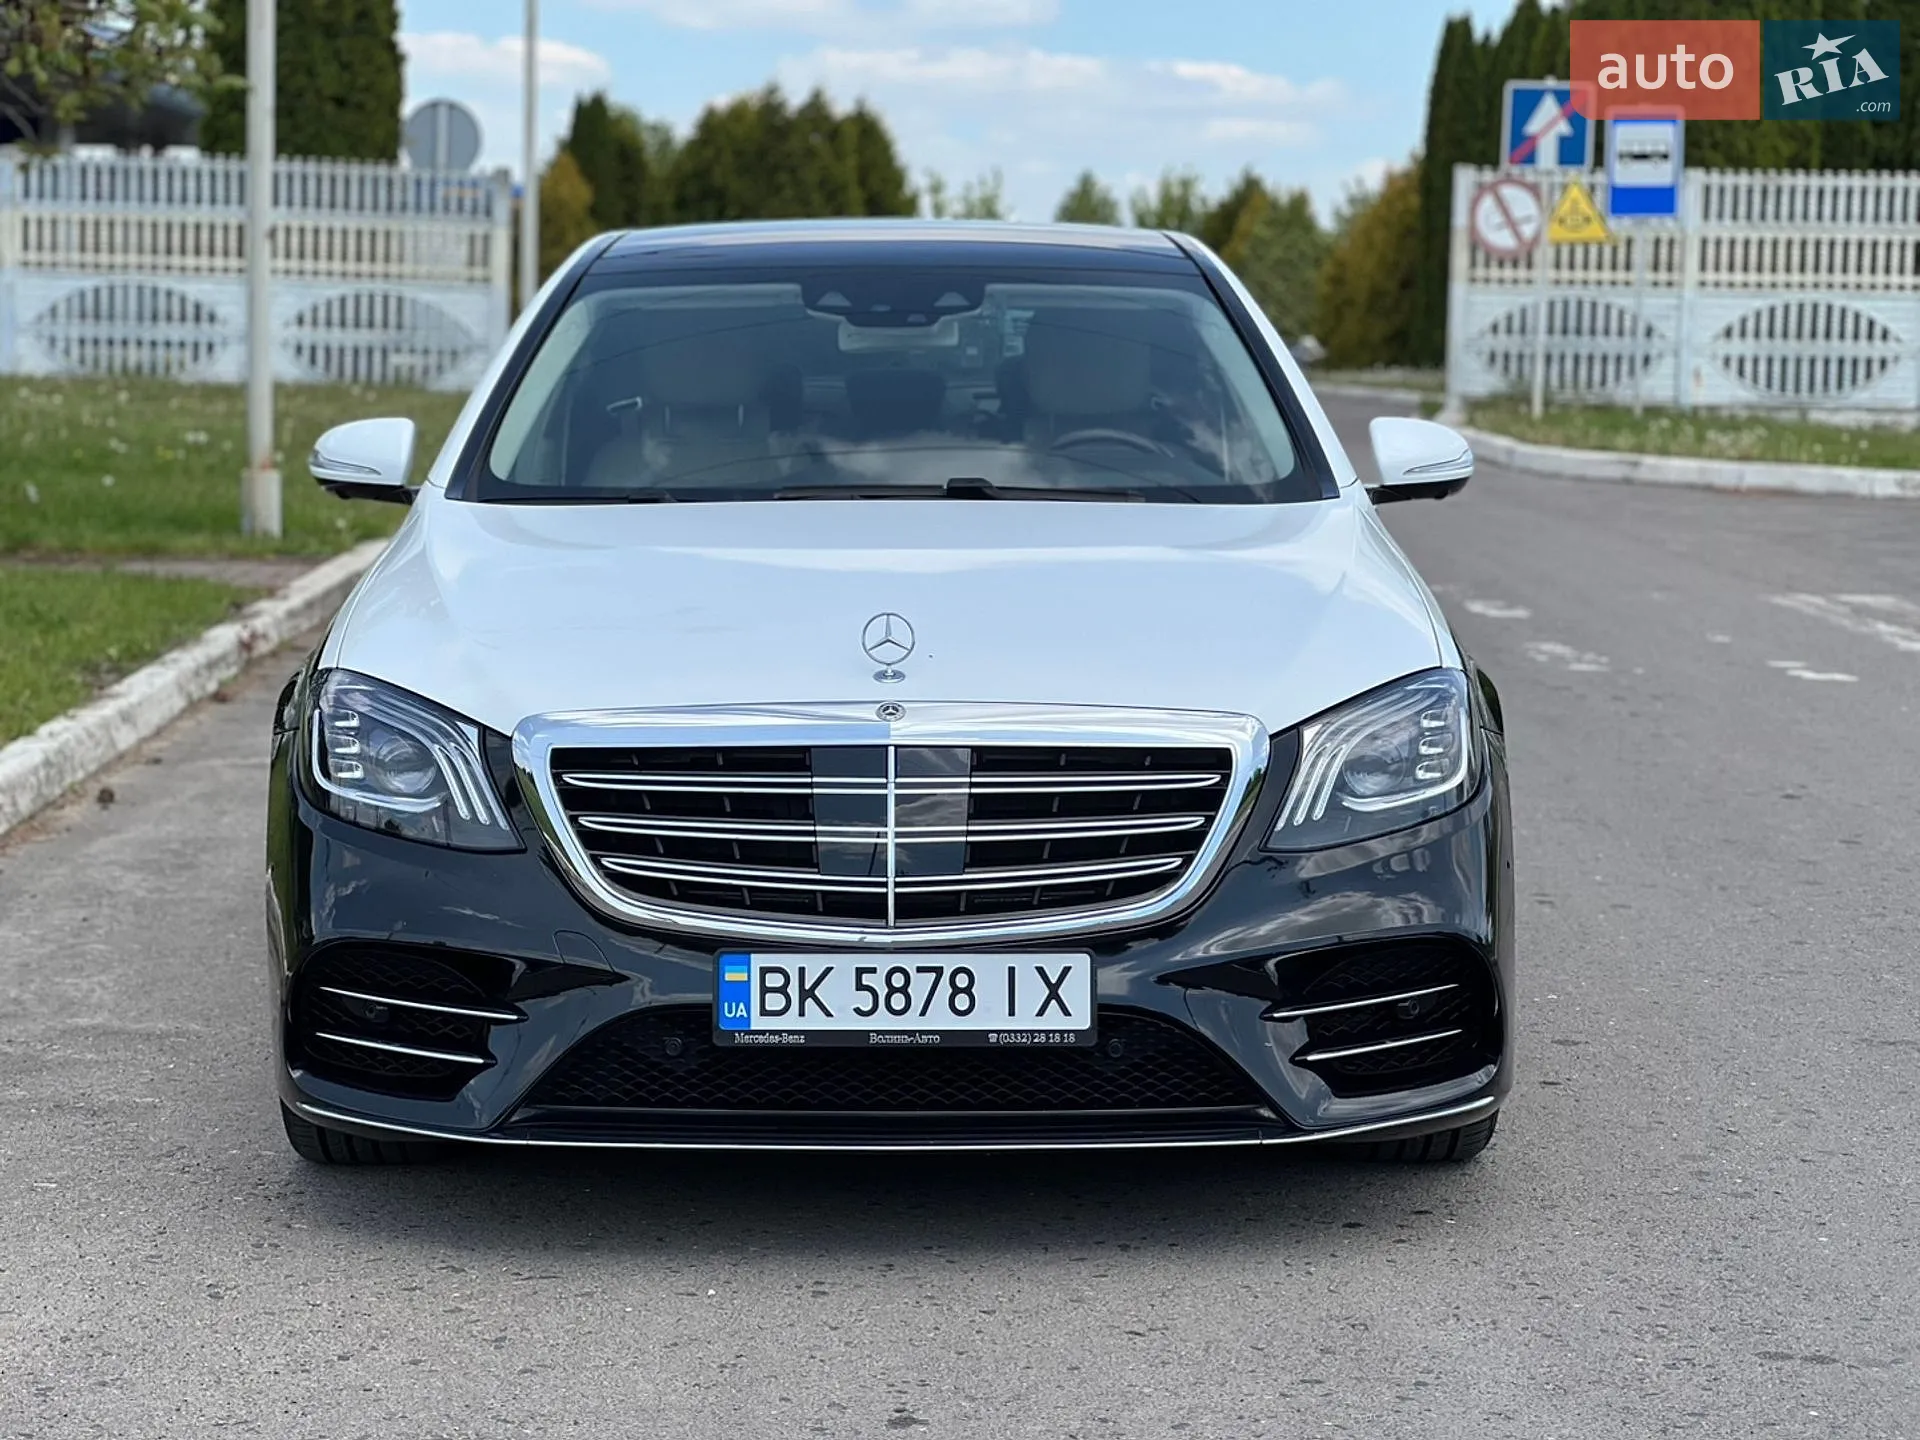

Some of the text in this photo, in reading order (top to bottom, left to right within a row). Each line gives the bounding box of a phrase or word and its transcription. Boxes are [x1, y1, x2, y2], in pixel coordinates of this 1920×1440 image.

[758, 965, 1073, 1018] BK 5878 IX
[724, 1003, 748, 1018] UA
[734, 1032, 806, 1044] Mercedes-Benz
[1000, 1033, 1032, 1045] (0332)
[1049, 1033, 1061, 1043] 18
[1063, 1033, 1076, 1043] 18
